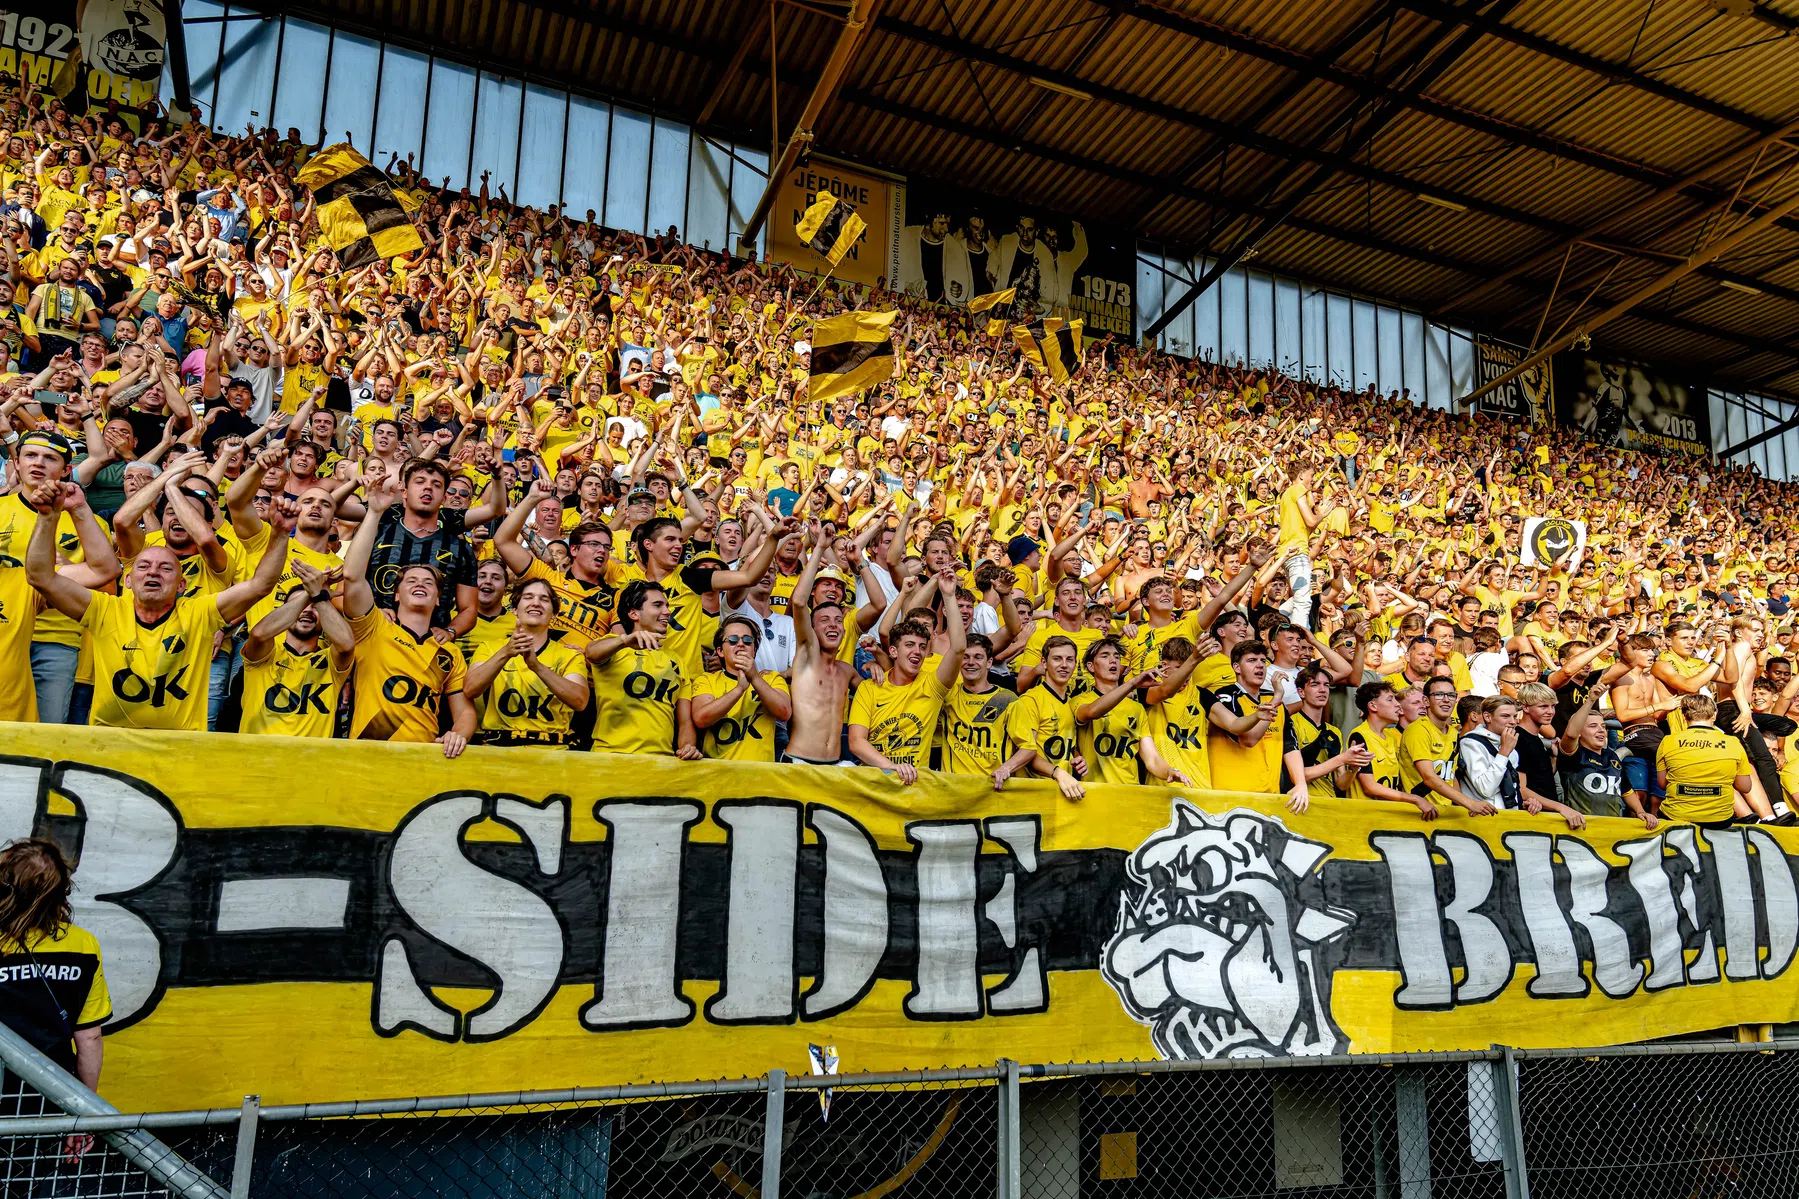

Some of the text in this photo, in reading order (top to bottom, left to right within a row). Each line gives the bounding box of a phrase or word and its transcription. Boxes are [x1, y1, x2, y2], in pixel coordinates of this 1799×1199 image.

[106, 47, 162, 63] N.A.C.
[891, 184, 902, 289] www.petitnatuursteen.n
[1081, 275, 1131, 307] 1973
[1067, 294, 1131, 322] WINNAAR
[1090, 313, 1131, 336] BEKER
[1662, 414, 1697, 441] 2013
[112, 664, 190, 708] OK
[264, 683, 332, 715] OK
[382, 675, 441, 714] OK
[623, 670, 680, 709] OK
[498, 688, 557, 723] OK
[713, 713, 764, 745] OK
[953, 721, 997, 748] cm.
[1166, 722, 1202, 750] OK
[953, 742, 998, 761] PAYMENTS
[1094, 733, 1140, 760] OK
[1678, 738, 1713, 750] Vrolijk
[1583, 772, 1622, 796] OK
[0, 964, 82, 982] STEWARD
